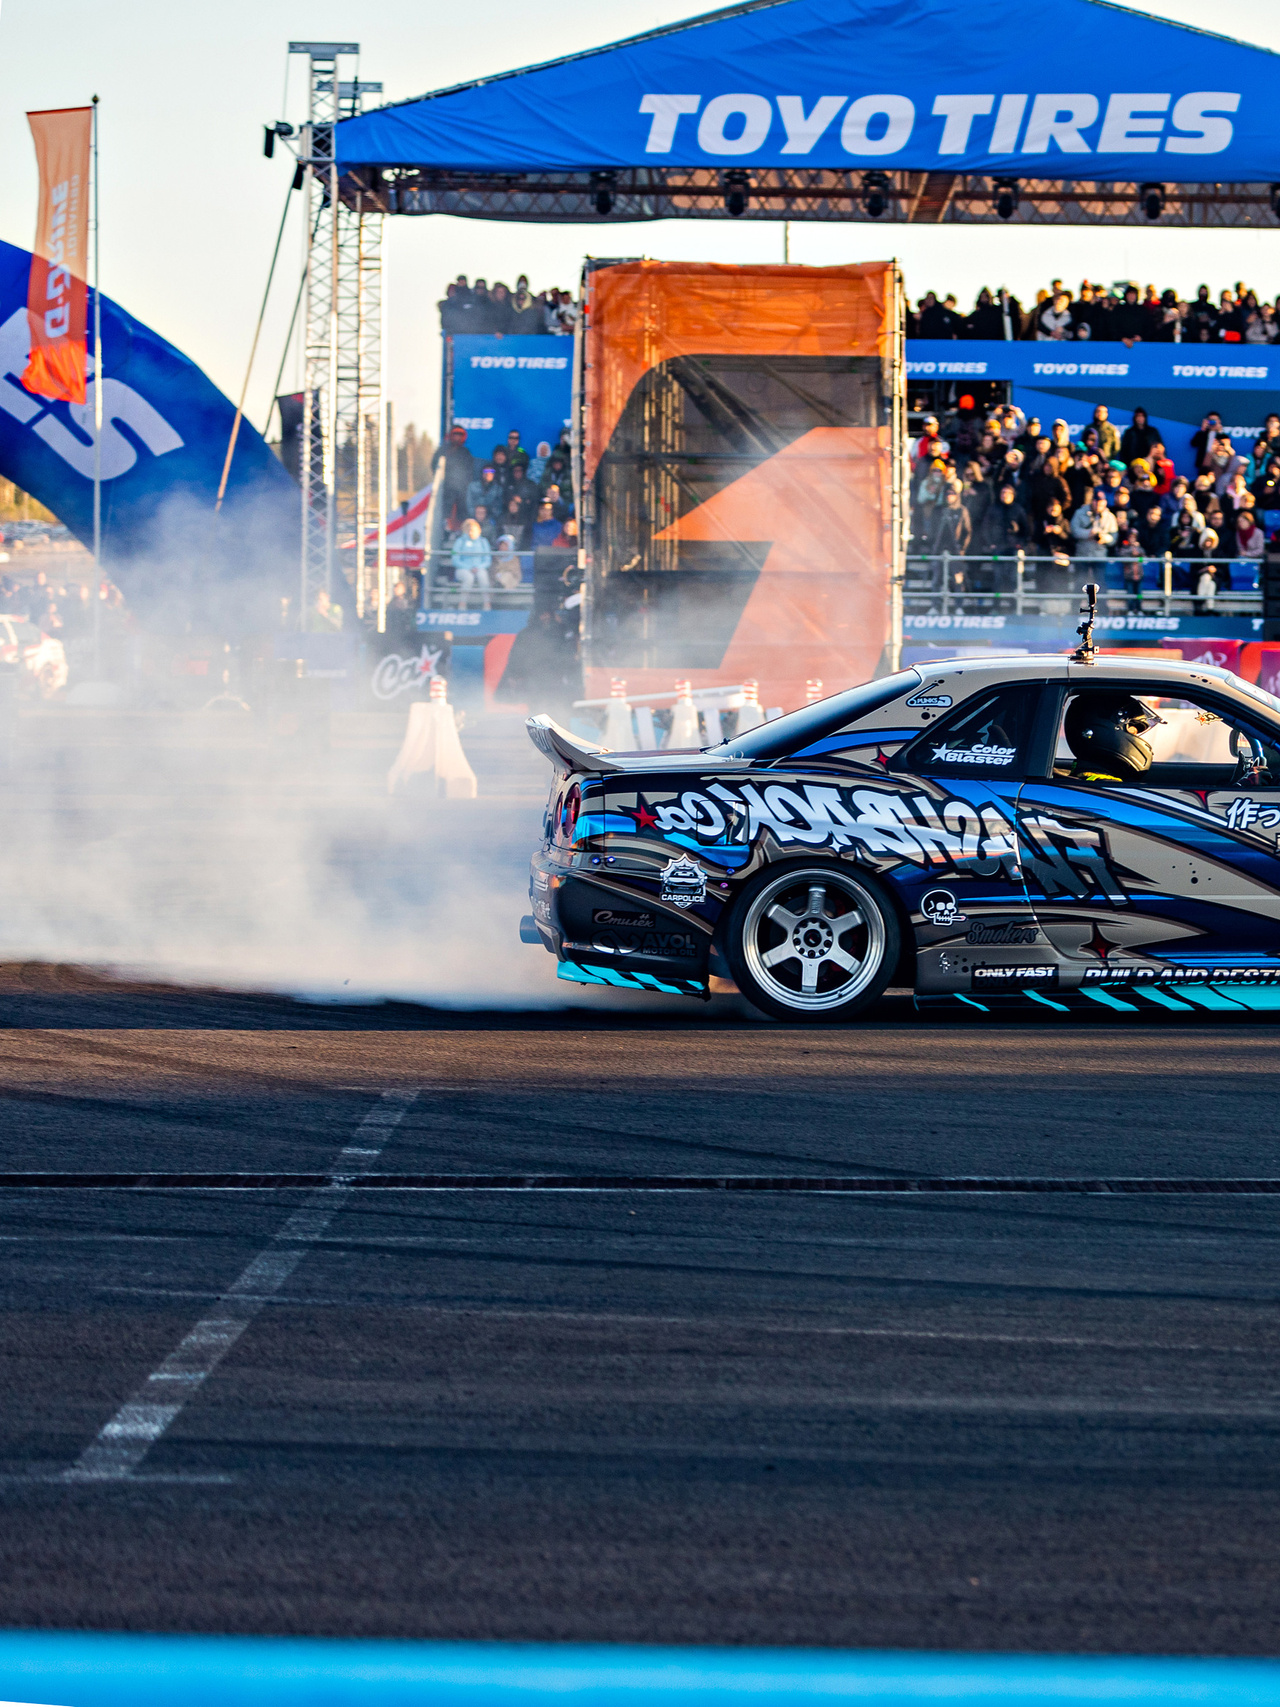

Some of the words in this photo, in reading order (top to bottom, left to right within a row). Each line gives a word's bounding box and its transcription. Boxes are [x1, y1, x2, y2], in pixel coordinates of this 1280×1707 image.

[638, 93, 916, 156] TOYO
[932, 91, 1241, 156] TIRES
[470, 356, 516, 369] TOYO
[517, 357, 568, 369] TIRES
[906, 362, 937, 374] OYO
[938, 362, 988, 374] TIRES
[1033, 363, 1080, 376] TOYO
[1080, 363, 1130, 376] TIRES
[1172, 365, 1218, 378] TOYO
[1219, 366, 1269, 379] TIRES
[453, 417, 494, 430] RES
[428, 613, 482, 626] TIRES
[904, 615, 954, 629] TOYO
[954, 615, 1007, 629] TIRES
[1126, 616, 1180, 630] TIRES
[971, 744, 1016, 755] Color
[945, 752, 1013, 765] Blaster
[661, 894, 705, 904] CARPOLICE
[967, 921, 1039, 944] Smokers
[643, 947, 677, 955] MOTOR
[974, 967, 1015, 977] ONLY
[1016, 966, 1055, 977] FAST
